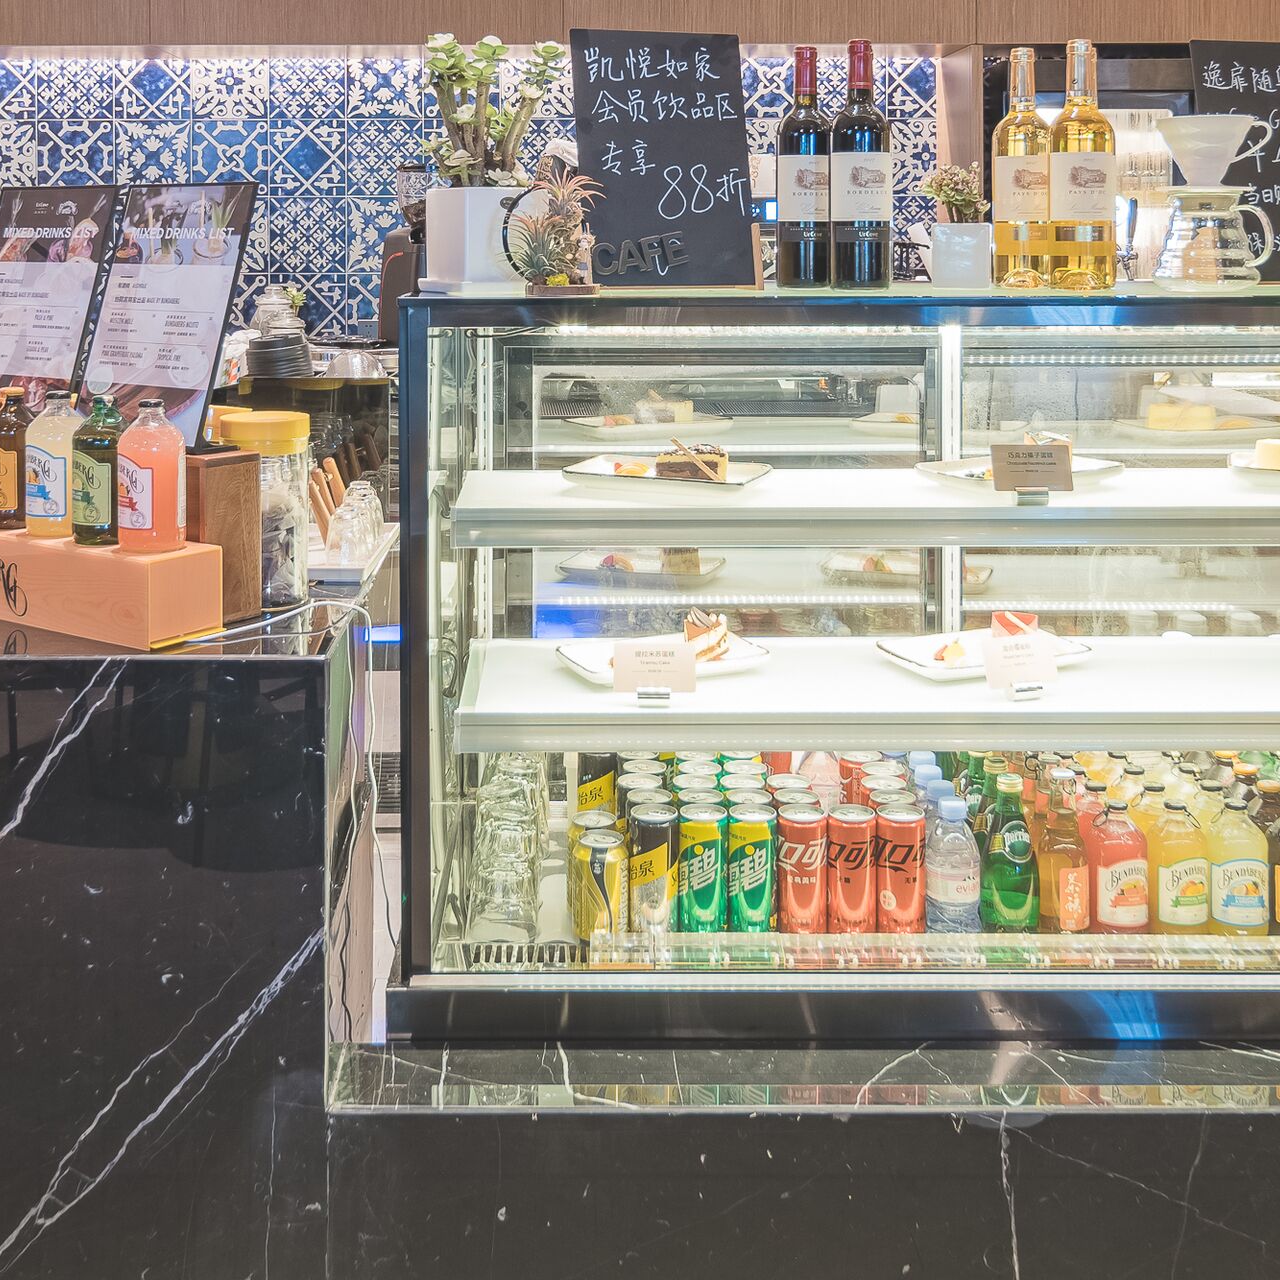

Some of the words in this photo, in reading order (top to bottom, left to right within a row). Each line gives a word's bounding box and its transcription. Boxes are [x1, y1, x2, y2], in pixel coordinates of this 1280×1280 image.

[584, 48, 720, 83] 凯悦如家
[591, 89, 738, 123] 会员饮品区
[601, 139, 656, 176] 专享
[657, 164, 748, 219] 88折
[3, 227, 36, 239] MIXED
[36, 227, 72, 239] DRINKS
[74, 227, 100, 239] LIST
[131, 227, 165, 240] MIXED
[165, 227, 206, 240] DRINKS
[209, 227, 235, 240] LIST
[591, 230, 689, 276] CAFE
